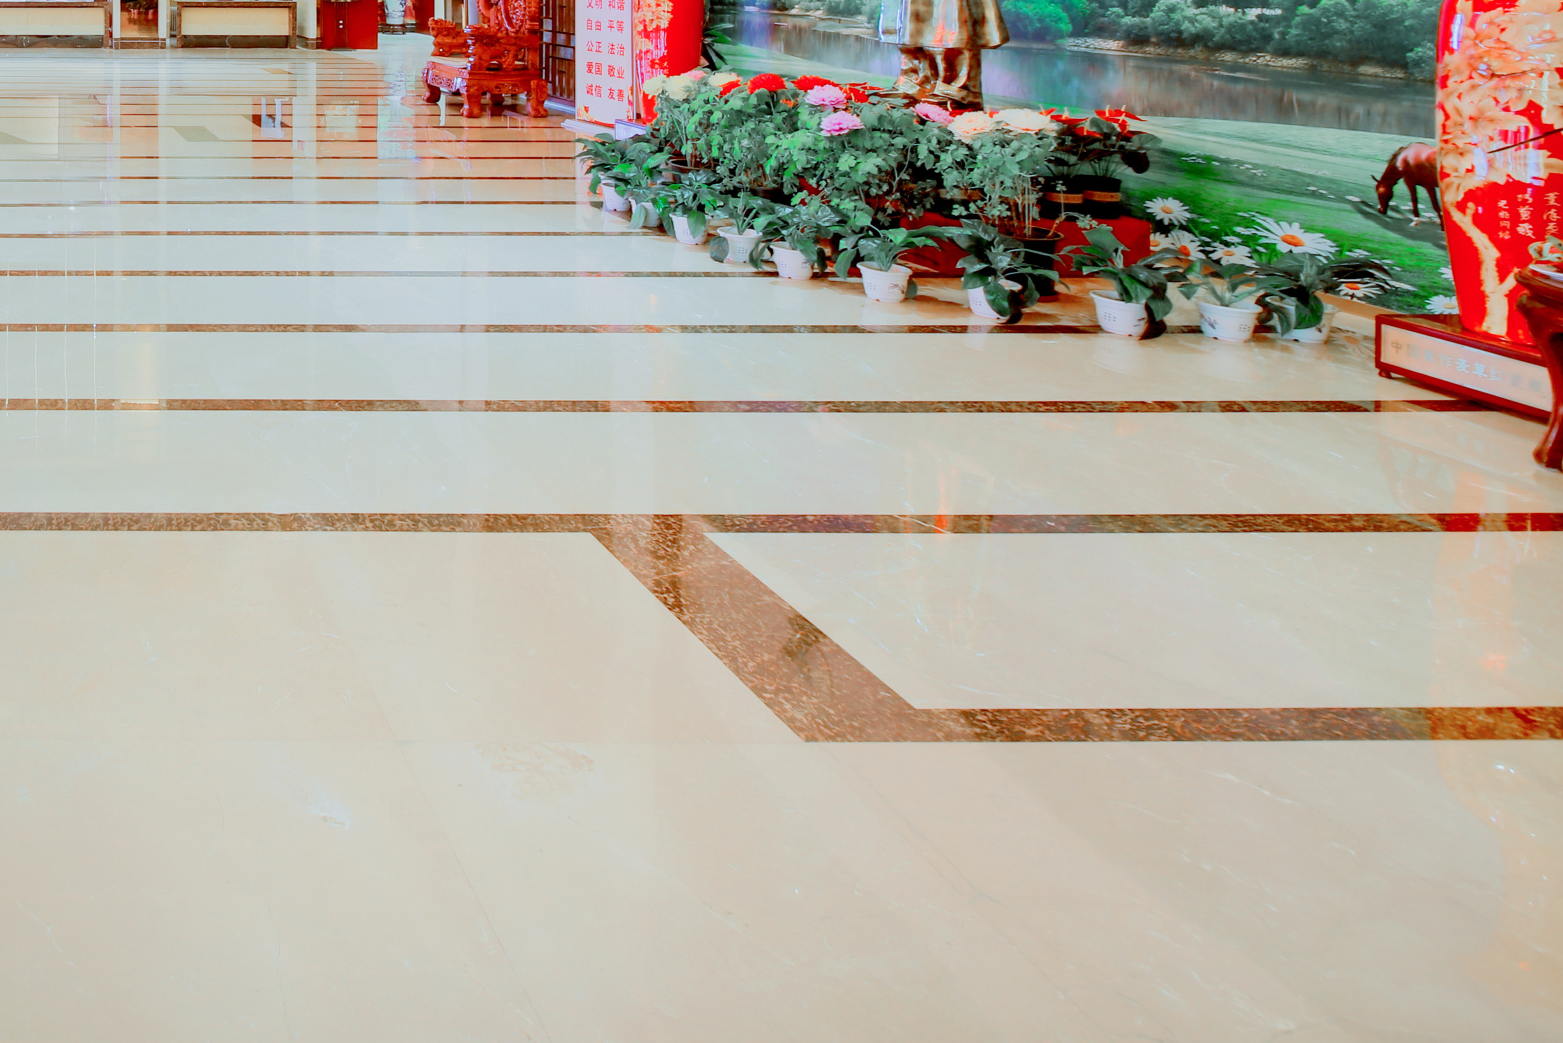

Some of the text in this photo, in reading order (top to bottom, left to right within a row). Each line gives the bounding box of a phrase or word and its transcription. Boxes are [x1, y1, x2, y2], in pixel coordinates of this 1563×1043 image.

[586, 18, 625, 33] 自由 平等
[586, 40, 625, 56] 公正 法治
[586, 61, 625, 79] 爱国 敬业
[586, 83, 625, 102] 诚信 友善
